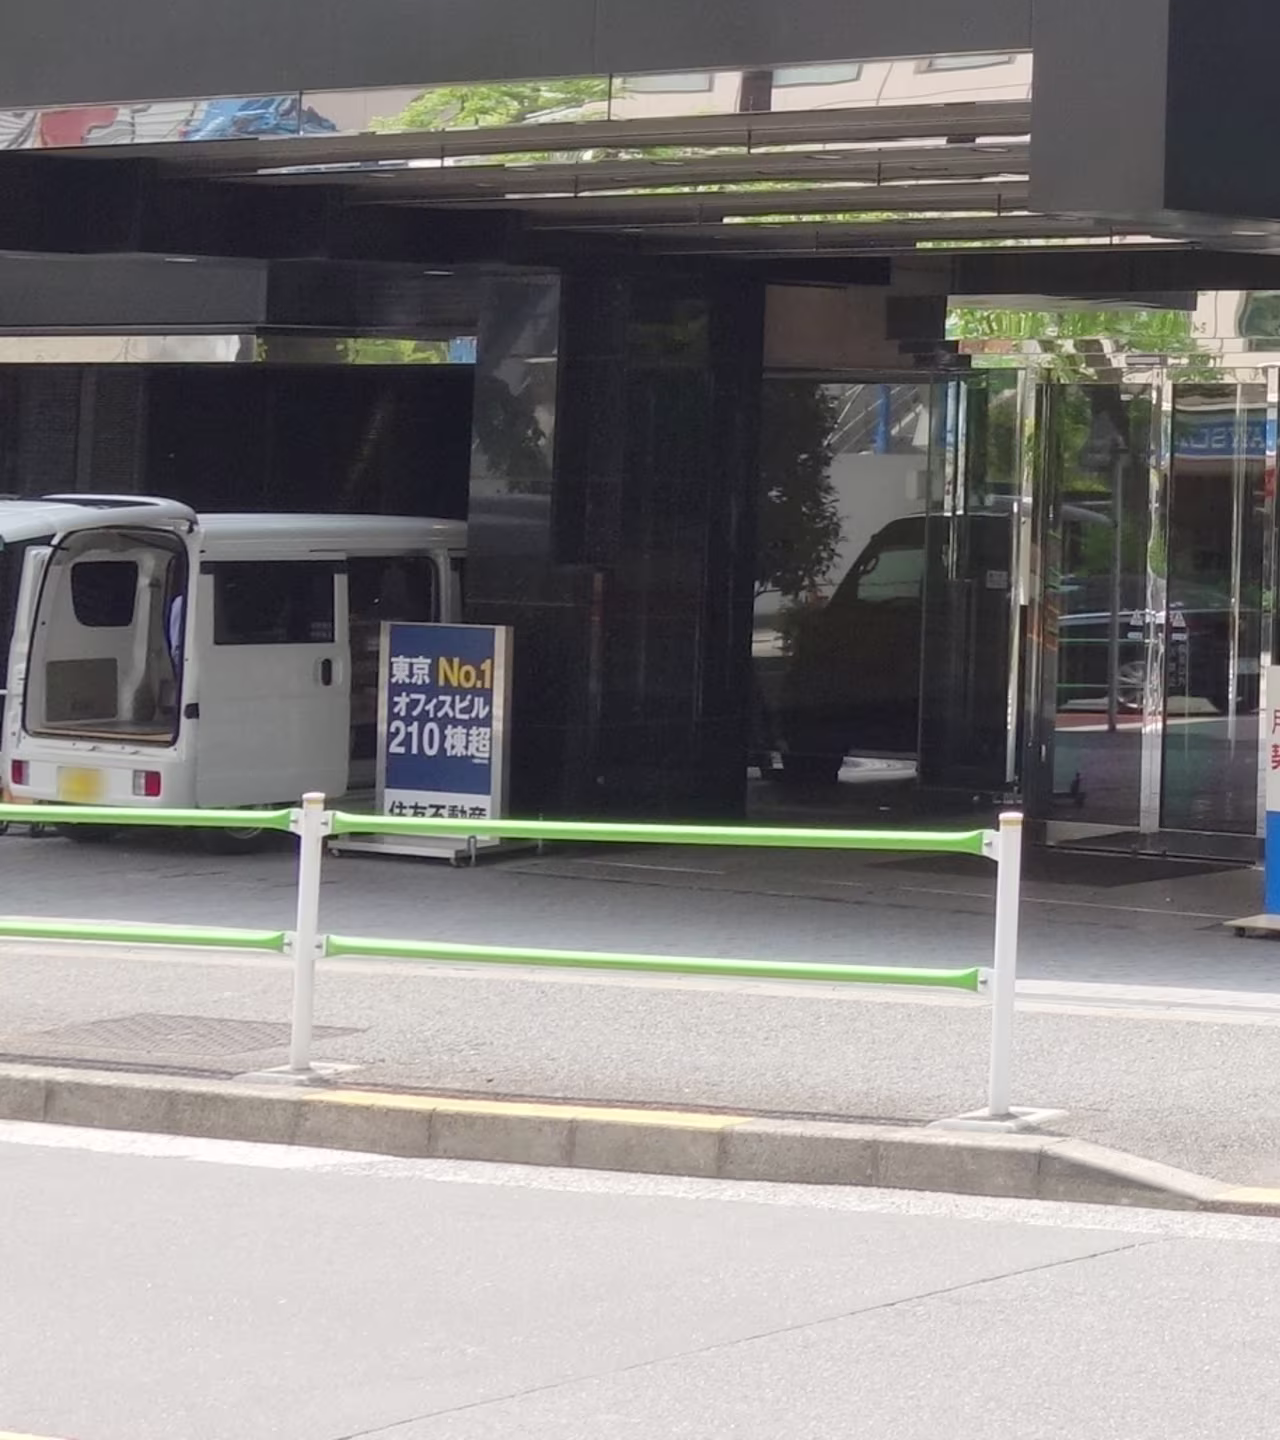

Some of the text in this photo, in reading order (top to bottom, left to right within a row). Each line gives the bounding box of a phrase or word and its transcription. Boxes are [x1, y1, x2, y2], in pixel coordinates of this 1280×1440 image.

[390, 655, 493, 689] 東京 No.1
[393, 691, 490, 721] オフィスビル
